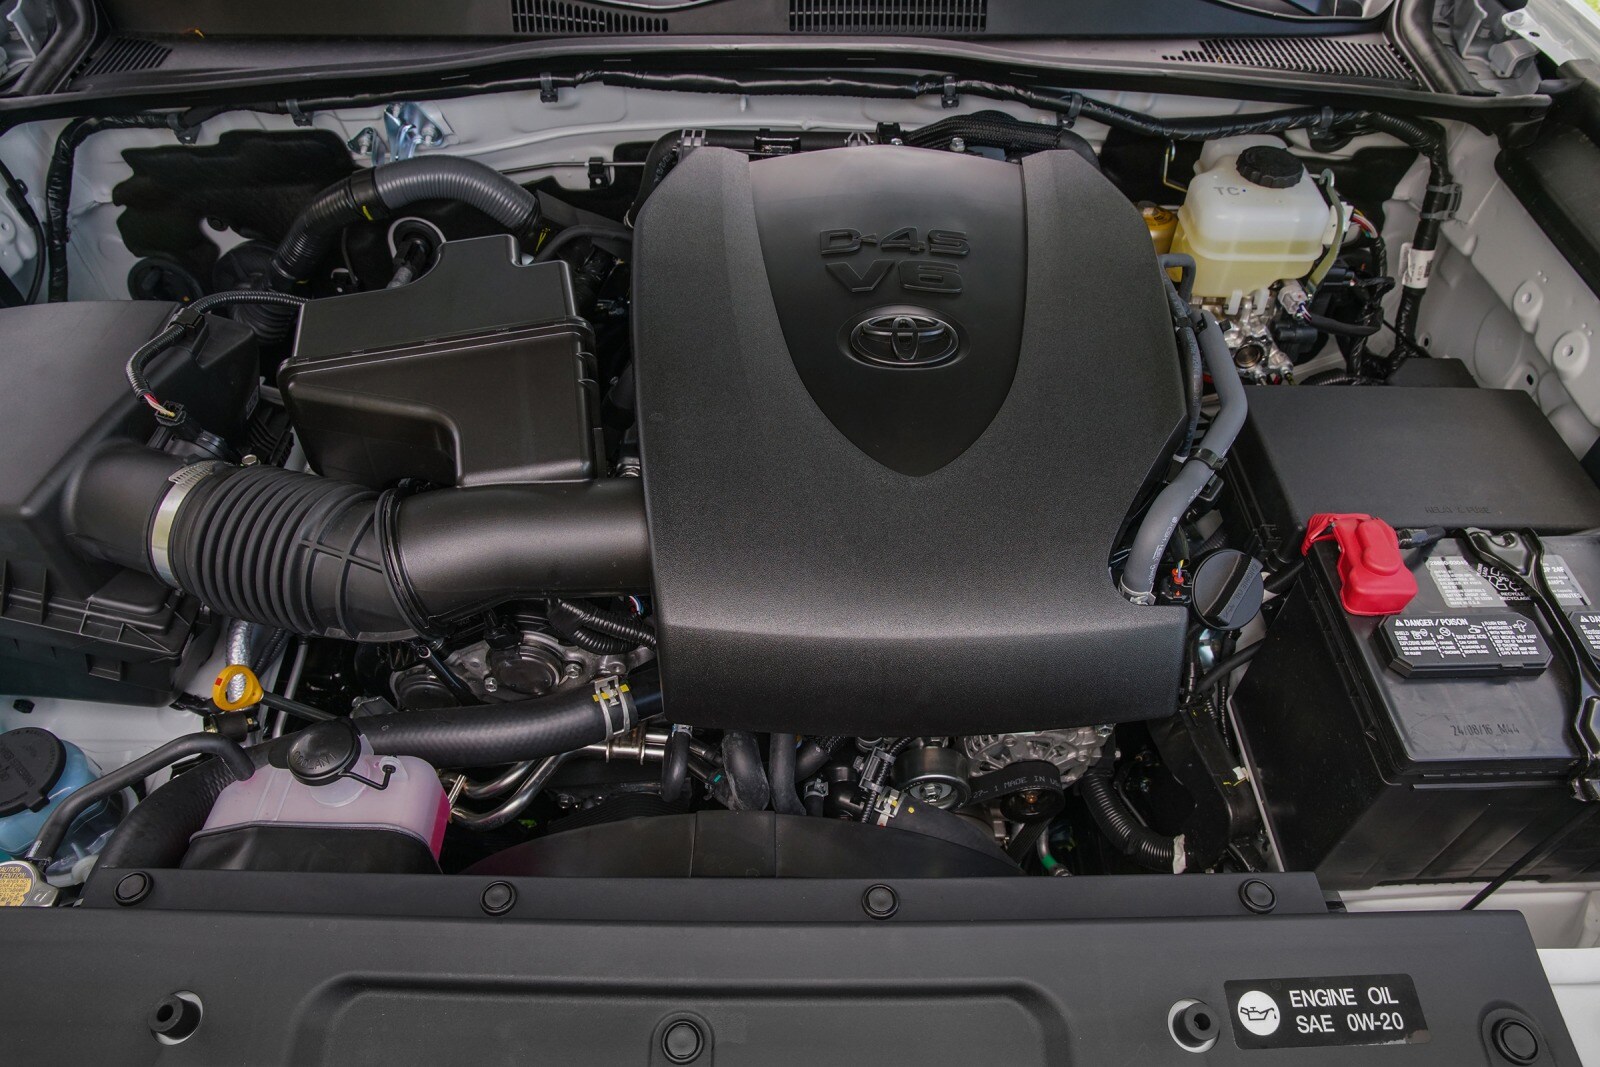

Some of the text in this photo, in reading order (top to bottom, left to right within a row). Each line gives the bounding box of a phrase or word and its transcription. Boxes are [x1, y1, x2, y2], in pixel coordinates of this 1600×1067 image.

[825, 259, 962, 294] V6
[1403, 619, 1434, 627] DANGER
[1440, 618, 1469, 626] POISON
[1450, 724, 1493, 736] 24/08/16
[1003, 777, 1027, 788] MADE
[1034, 775, 1046, 783] IN
[1289, 987, 1399, 1007] ENGINE OIL
[1296, 1012, 1404, 1033] SAE 0W-20
